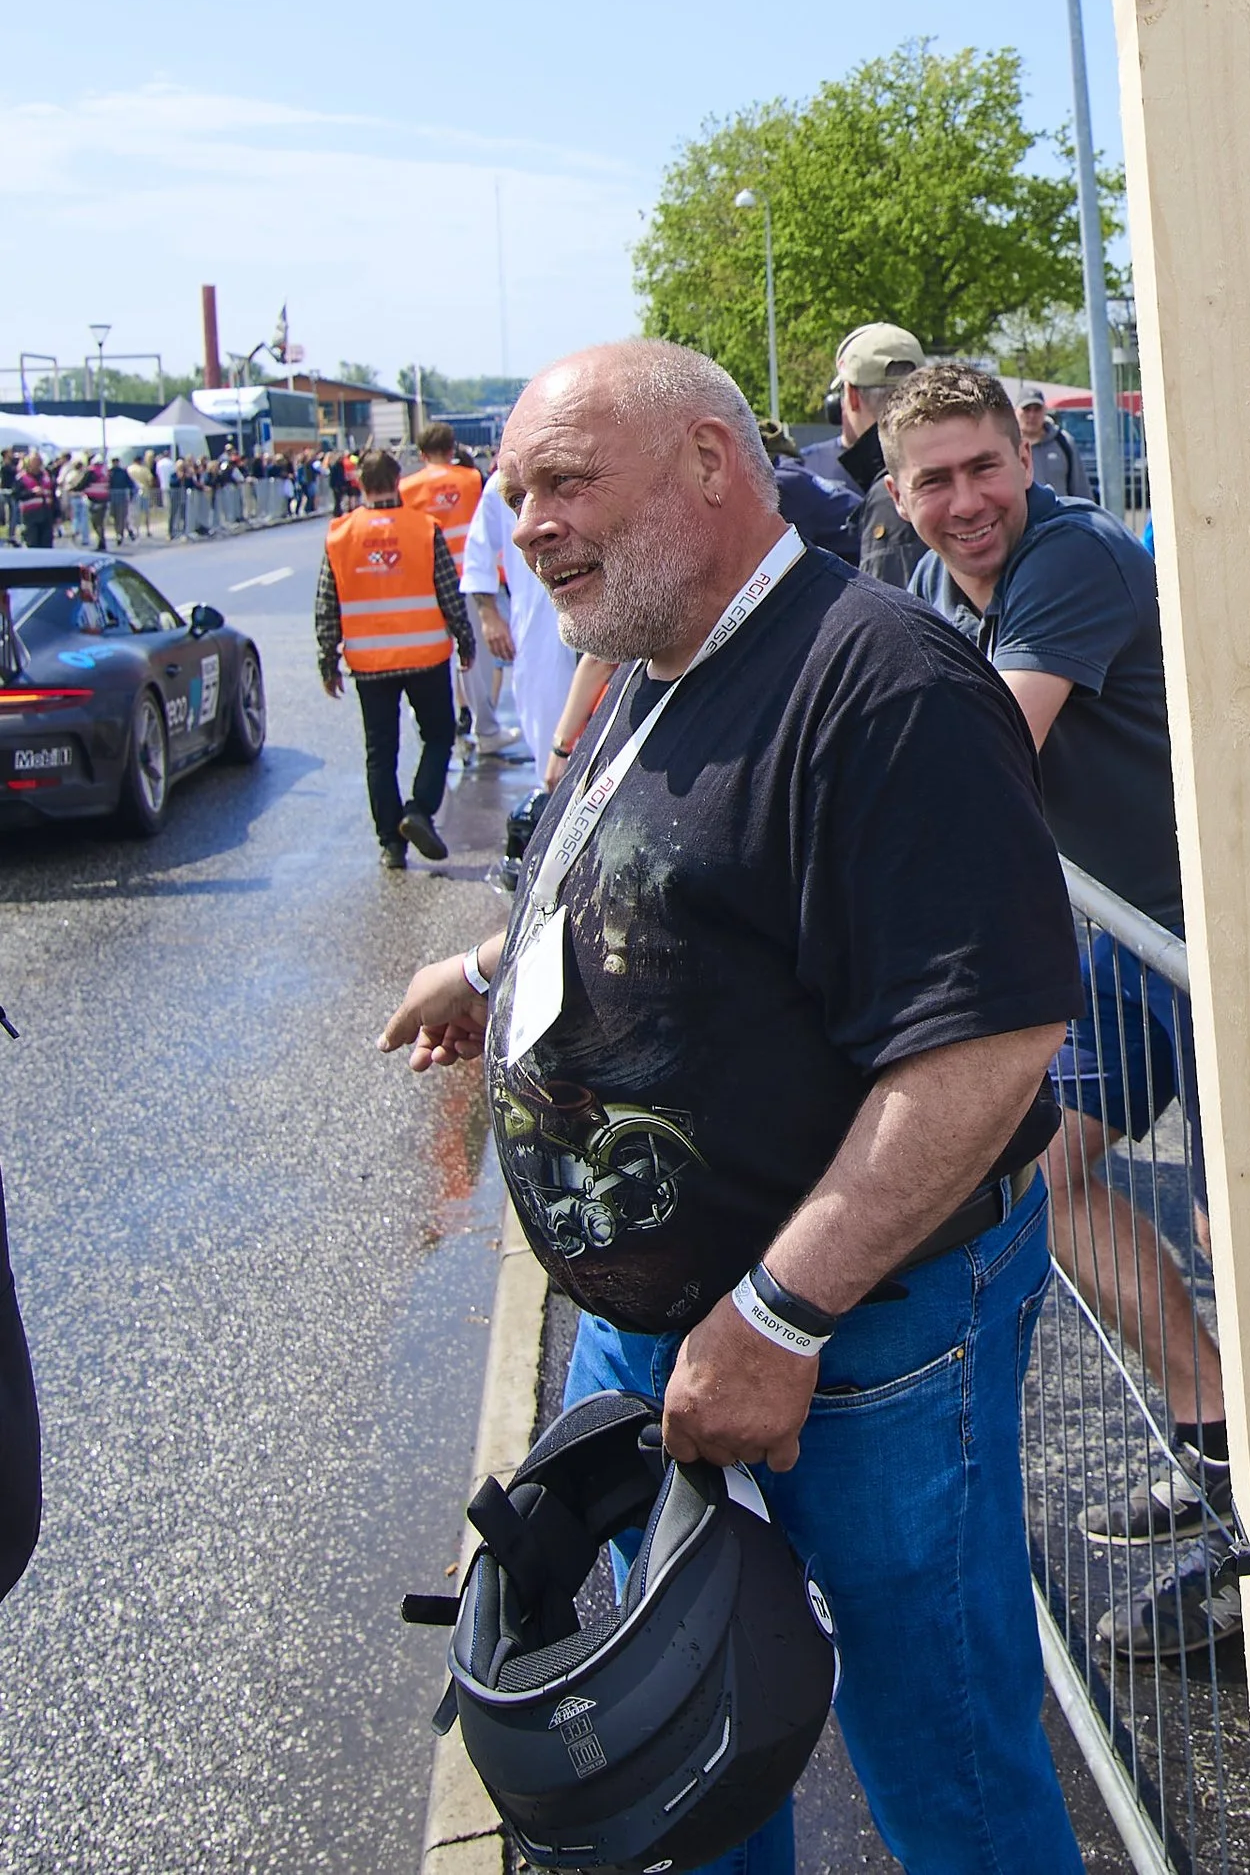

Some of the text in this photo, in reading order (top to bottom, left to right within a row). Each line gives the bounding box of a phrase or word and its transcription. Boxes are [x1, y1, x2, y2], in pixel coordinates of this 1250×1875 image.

[705, 572, 772, 654] AGILEASE
[554, 776, 615, 866] AGILEASE
[751, 1305, 811, 1347] READY TO GO
